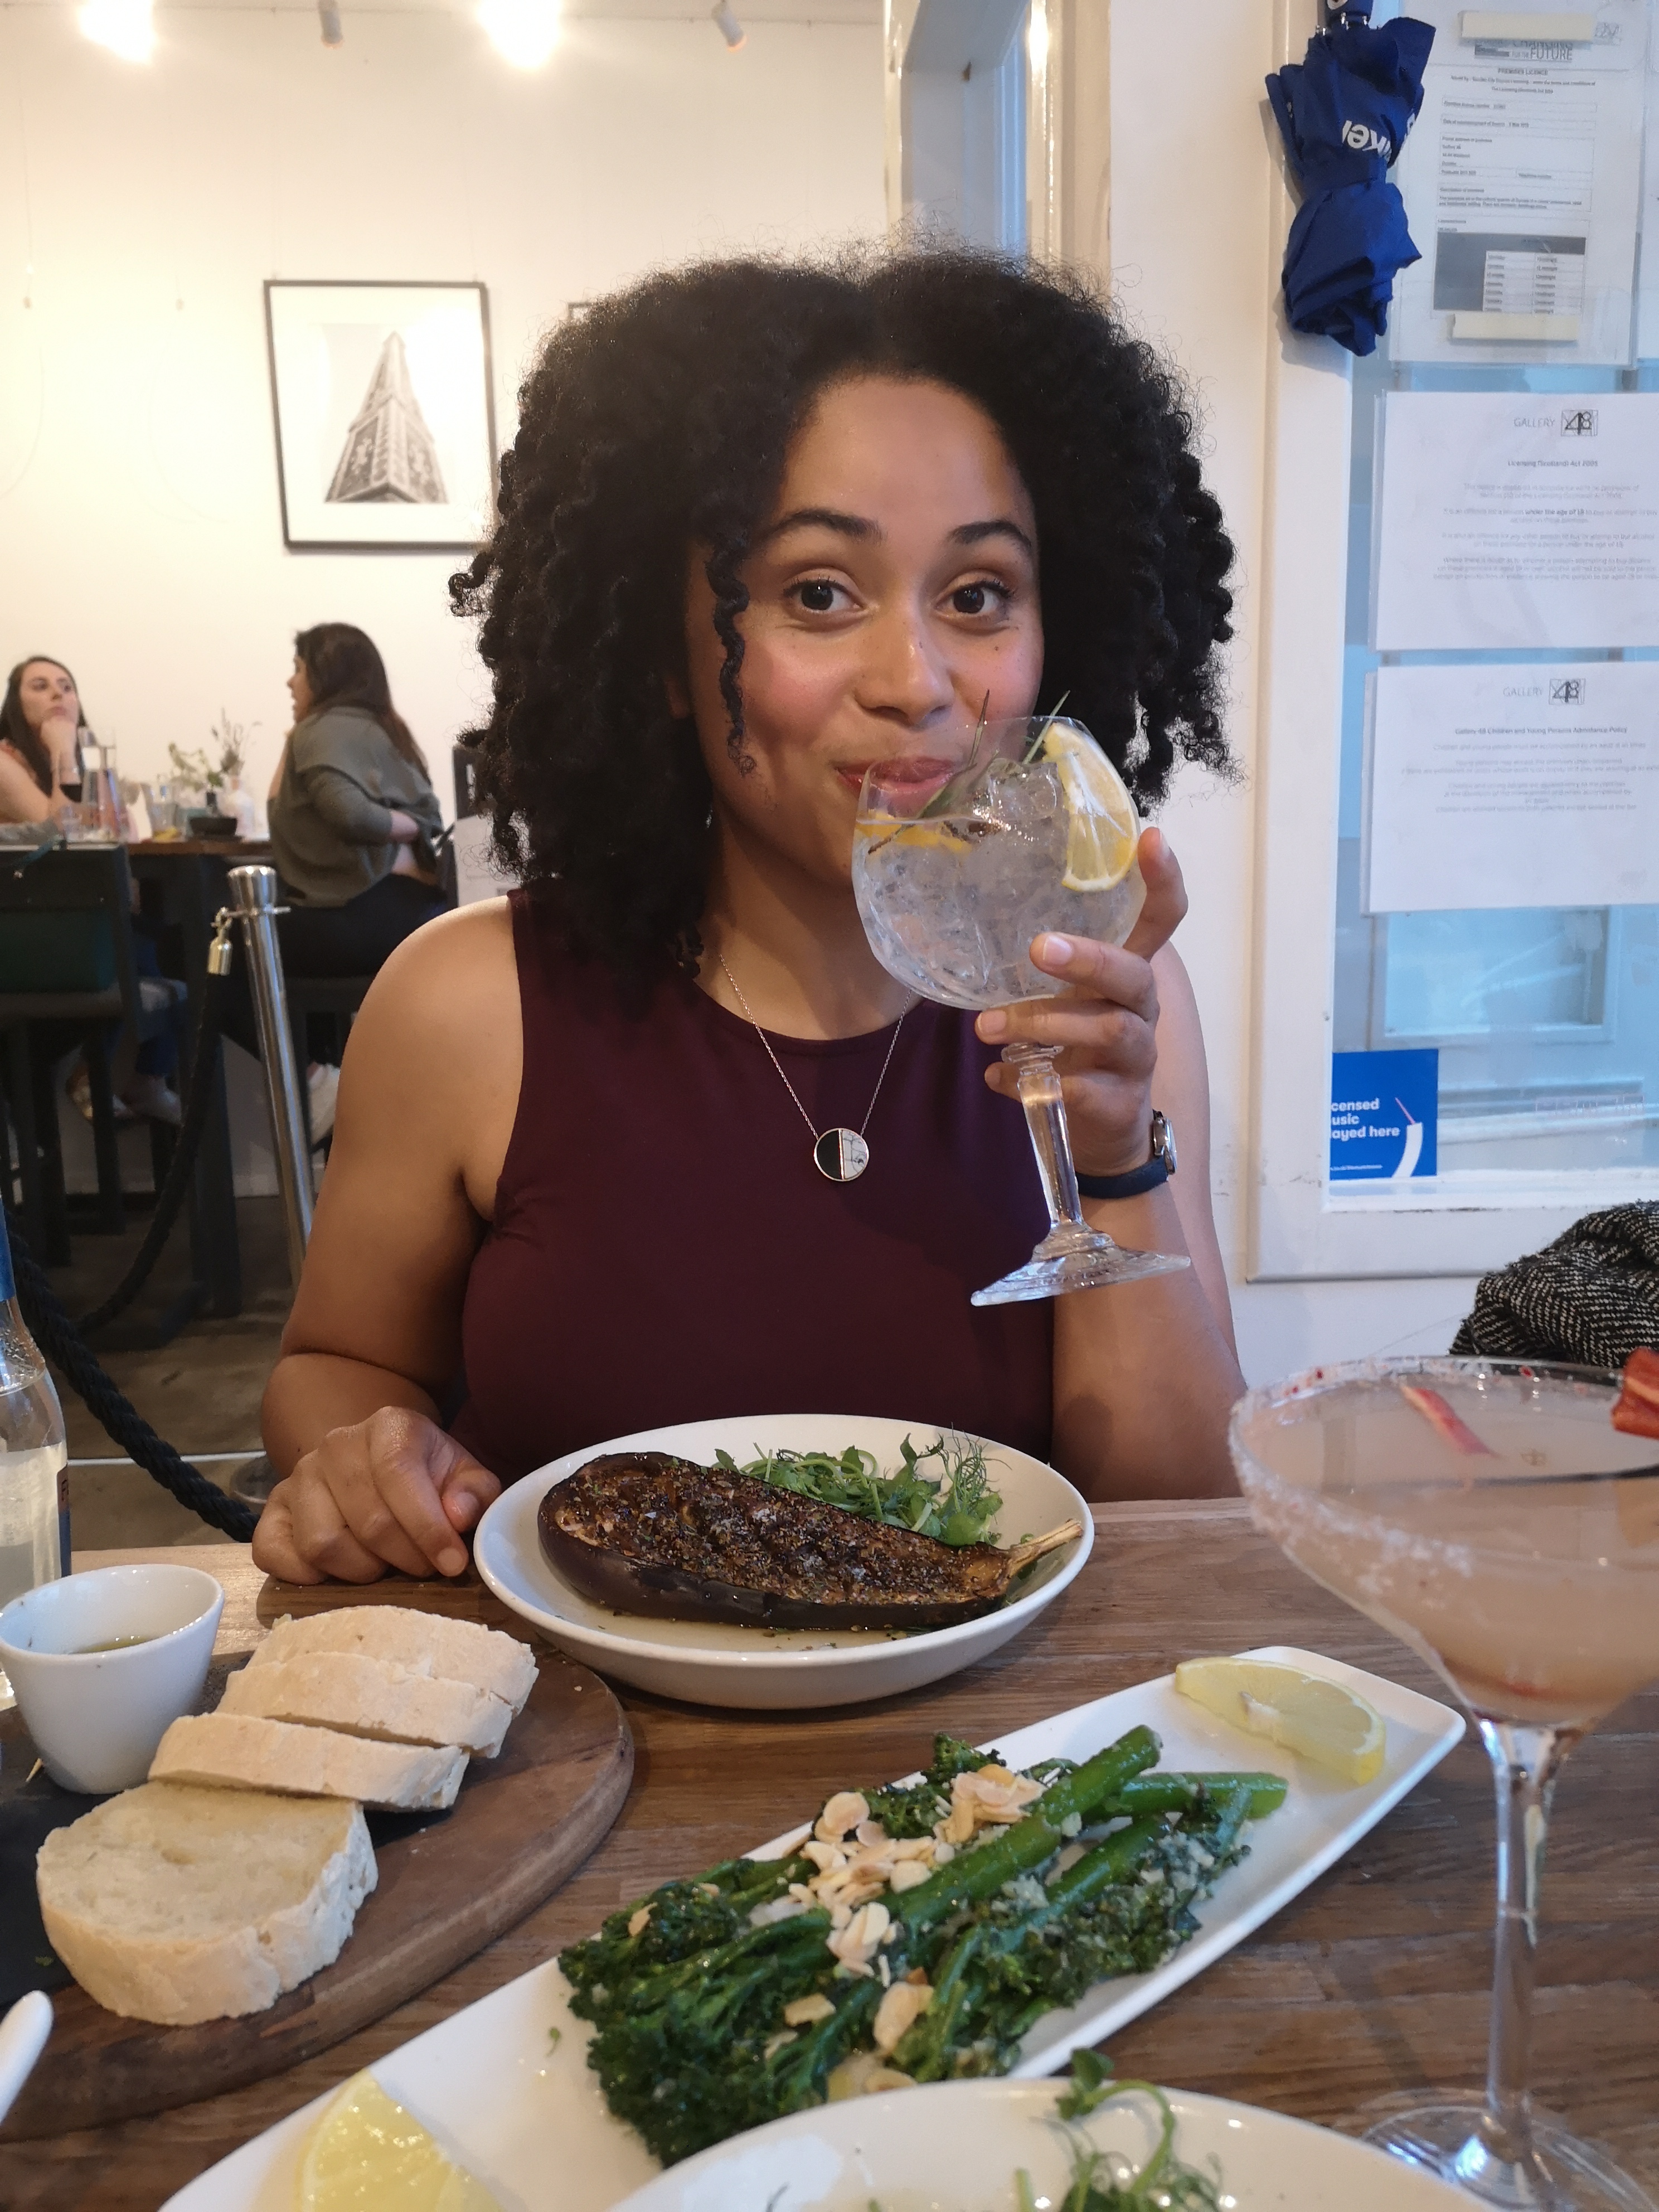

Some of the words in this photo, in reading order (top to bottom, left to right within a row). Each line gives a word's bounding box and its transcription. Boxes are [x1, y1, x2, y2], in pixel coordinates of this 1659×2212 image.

[1530, 48, 1573, 60] FUTURE
[1513, 417, 1555, 429] GALLERY
[1564, 411, 1593, 436] 48
[1503, 686, 1542, 697] GALLERY
[1331, 1097, 1380, 1112] censed
[1331, 1113, 1360, 1126] usic
[1331, 1126, 1366, 1142] ayed
[1369, 1125, 1401, 1137] here
